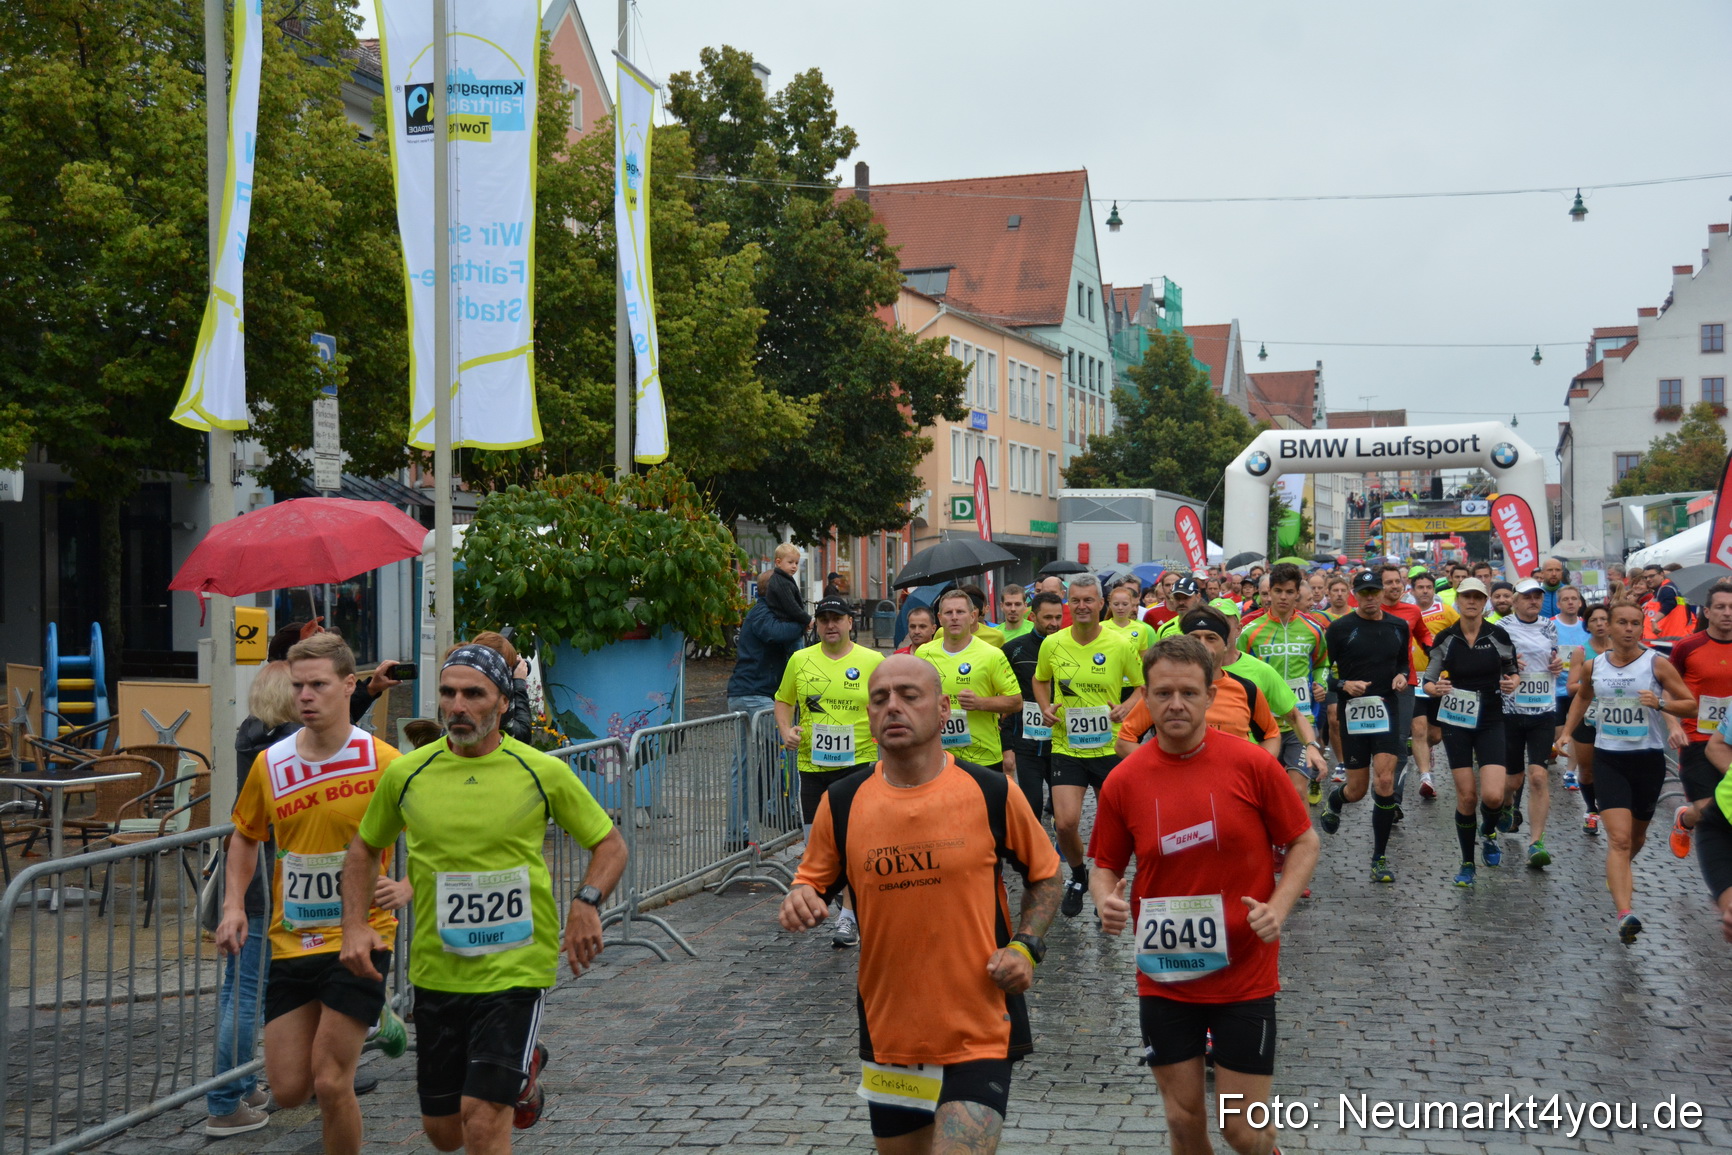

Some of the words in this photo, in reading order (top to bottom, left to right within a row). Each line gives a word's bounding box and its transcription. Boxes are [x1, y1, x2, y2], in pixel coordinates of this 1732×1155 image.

[1280, 438, 1348, 459] BMW
[1355, 434, 1480, 459] Laufsport
[1425, 520, 1449, 530] ZIEL
[1497, 503, 1534, 567] REWE
[1260, 644, 1312, 657] BOCK
[1519, 680, 1550, 694] 2090
[1350, 705, 1385, 720] 2705
[1443, 694, 1476, 715] 2812
[1070, 715, 1108, 733] 2910
[1602, 707, 1645, 725] 2004
[1616, 728, 1629, 736] Eva
[815, 733, 850, 751] 2911
[276, 791, 321, 820] MAX
[325, 778, 376, 802] BÖGL
[1175, 830, 1199, 845] DEHN
[875, 850, 940, 876] OEXL
[288, 871, 342, 900] 2708
[297, 907, 340, 918] Thomas
[447, 888, 523, 924] 2526
[468, 931, 504, 944] Oliver
[1142, 916, 1217, 950] 2649
[1157, 956, 1205, 970] Thomas
[870, 1074, 920, 1094] Christian
